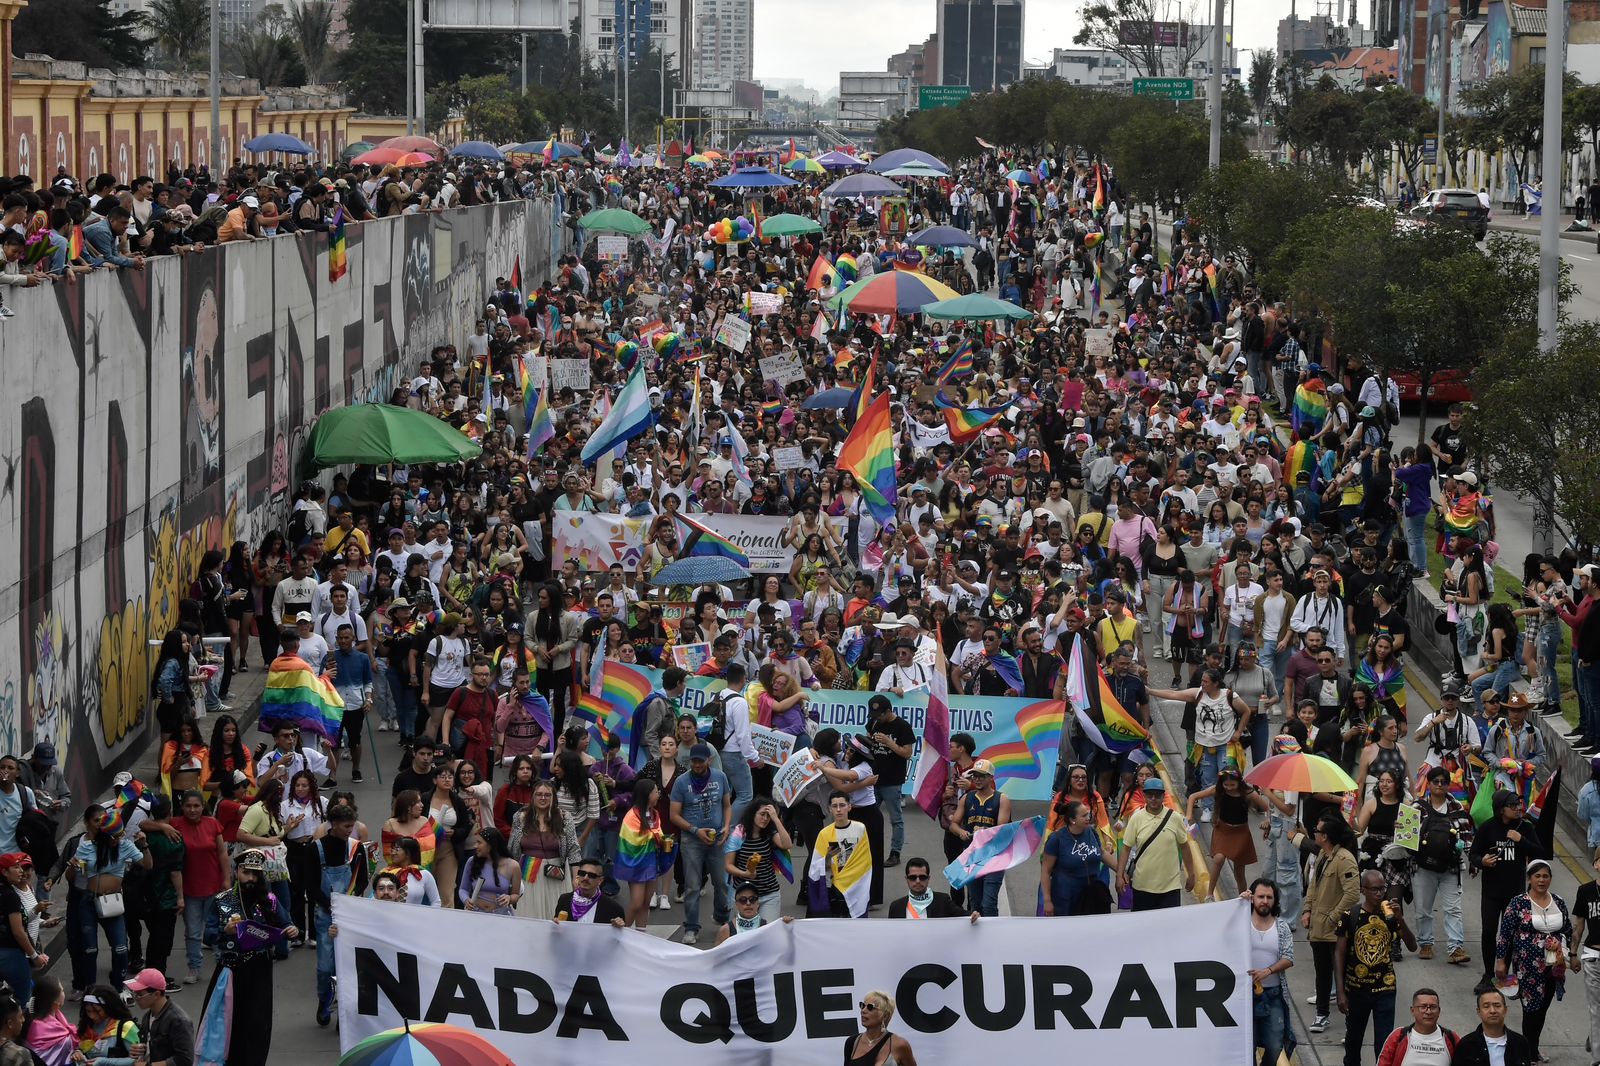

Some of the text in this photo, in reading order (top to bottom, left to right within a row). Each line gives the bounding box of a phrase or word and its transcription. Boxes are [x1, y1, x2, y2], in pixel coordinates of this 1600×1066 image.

[287, 588, 311, 596] JOAN
[893, 706, 993, 732] AFIRTIVAS
[355, 947, 1238, 1044] NADA QUE CURAR
